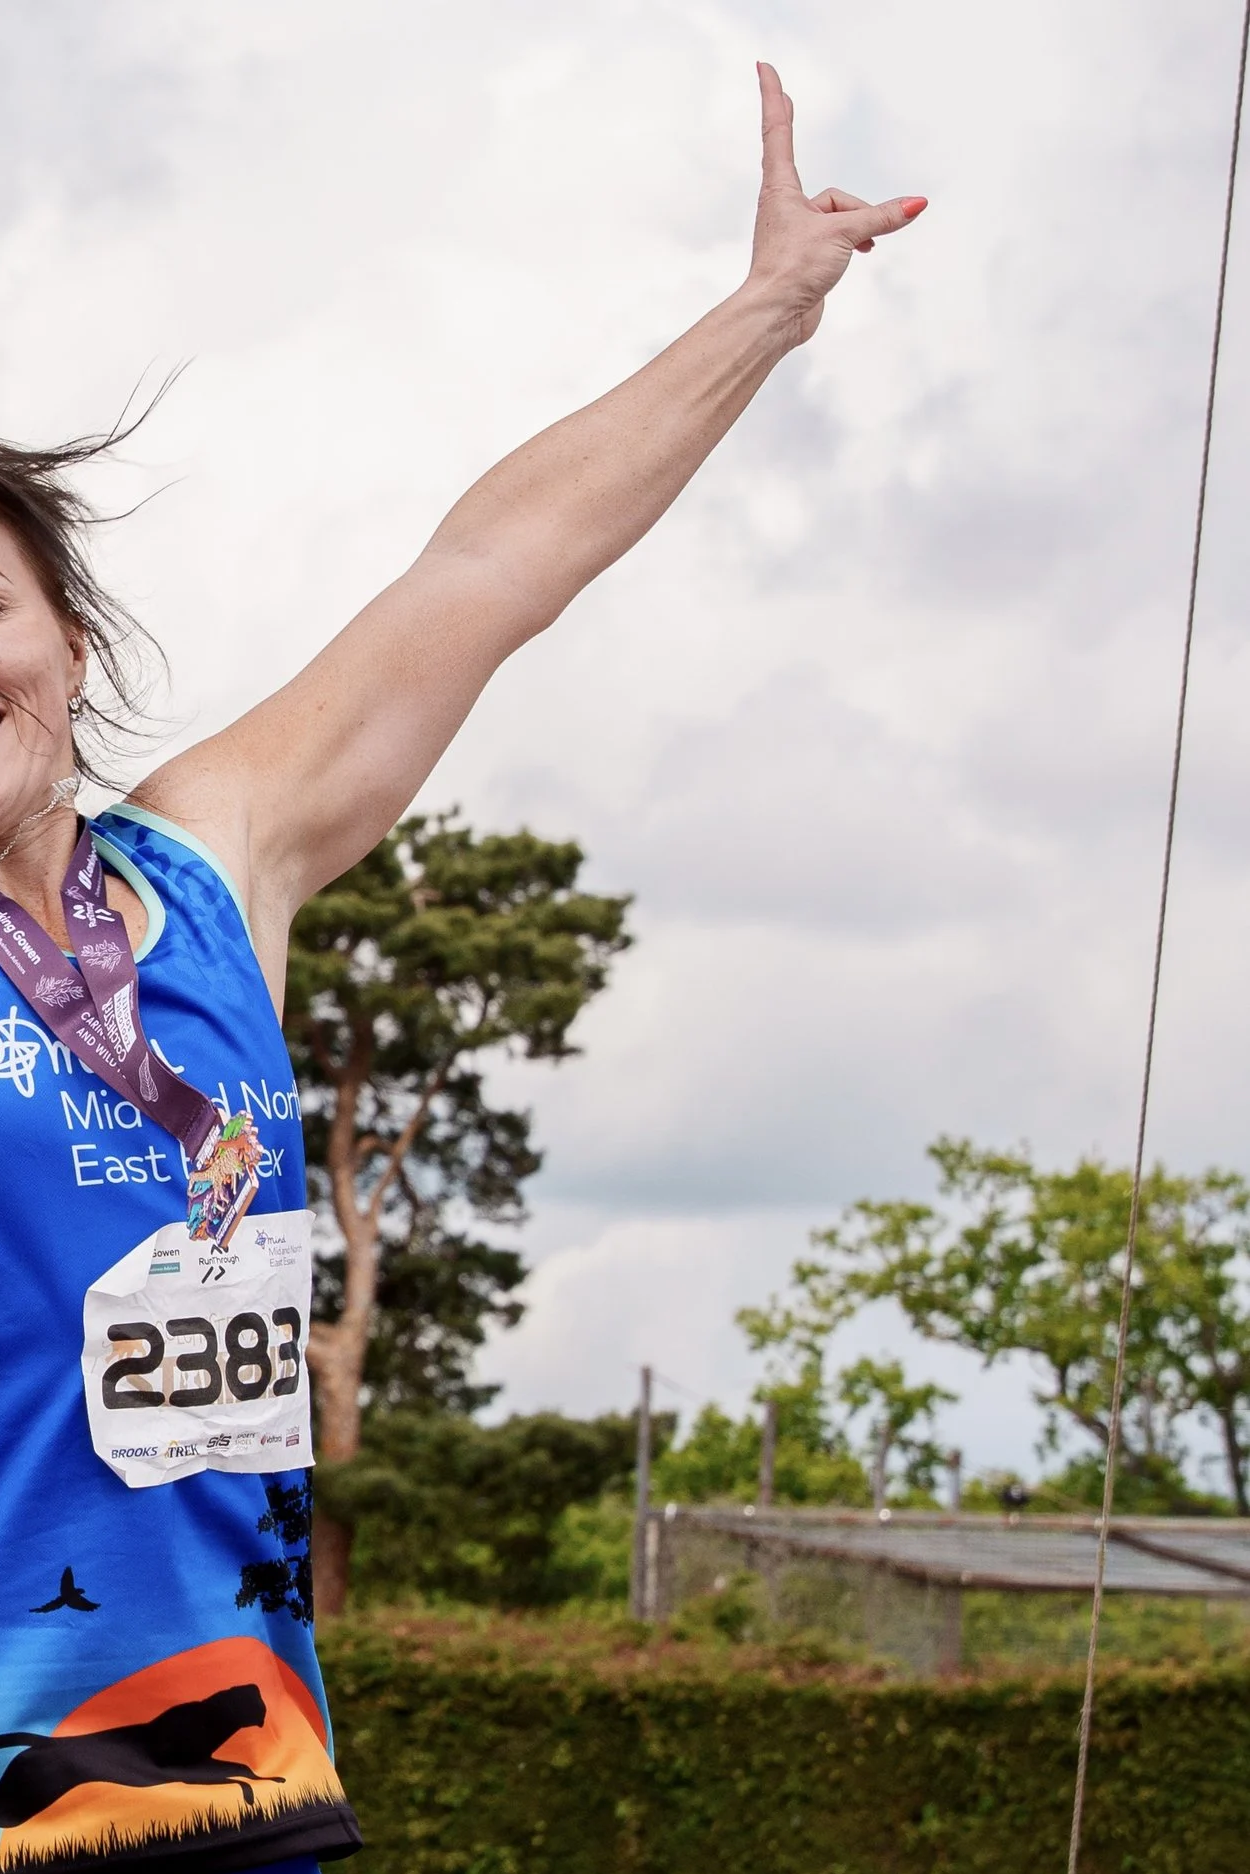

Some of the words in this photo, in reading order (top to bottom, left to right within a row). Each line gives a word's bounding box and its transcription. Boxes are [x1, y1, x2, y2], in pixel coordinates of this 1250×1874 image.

[13, 930, 41, 965] Gowen
[10, 954, 27, 975] Advisors
[76, 1028, 96, 1046] AND
[102, 997, 127, 1062] COLCHESTER
[72, 1144, 171, 1187] East
[199, 1254, 240, 1266] RunThrough
[270, 1258, 283, 1267] East
[102, 1306, 301, 1409] 2383
[111, 1446, 158, 1459] BROOKS
[167, 1444, 200, 1459] TREK
